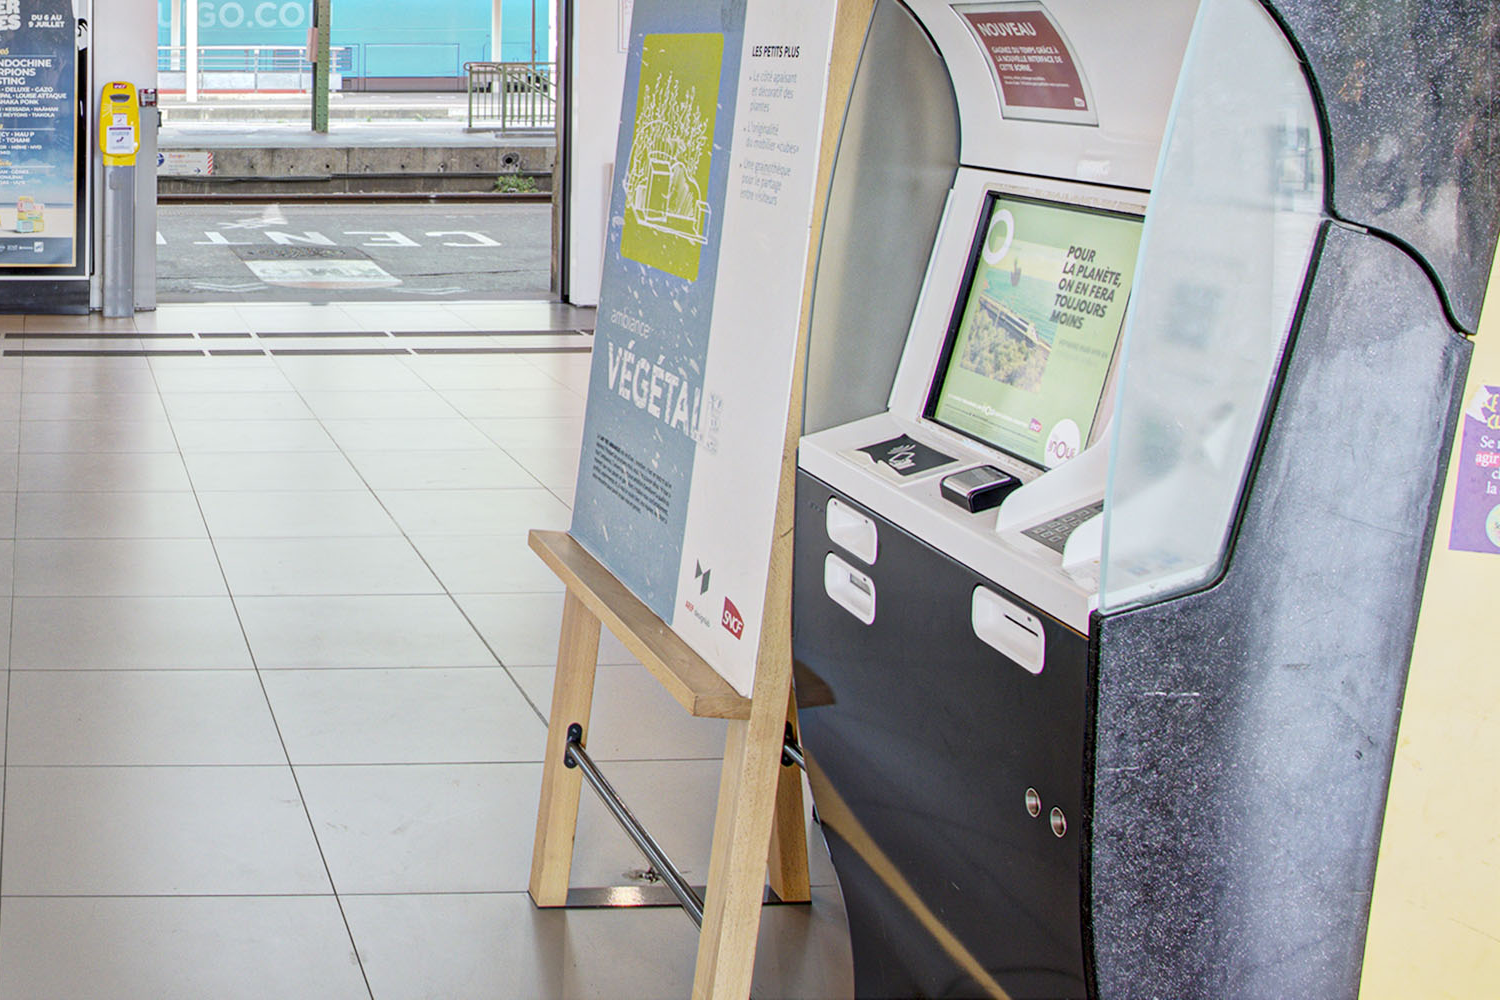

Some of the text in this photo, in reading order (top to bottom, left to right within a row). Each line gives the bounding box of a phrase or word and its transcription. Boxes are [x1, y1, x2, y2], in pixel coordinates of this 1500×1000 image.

[977, 22, 1037, 37] NOUVEAU
[751, 45, 801, 58] LES PETITS PLUS
[1012, 46, 1020, 54] DU
[995, 55, 1003, 63] LA
[1003, 55, 1027, 63] NOUVELLE
[1028, 55, 1054, 64] INTERFACE
[1067, 246, 1096, 263] POUR
[1063, 262, 1122, 288] LA PLANÈTE,
[1058, 277, 1115, 303] ON EN FERA
[1054, 293, 1108, 319] TOUJOURS
[611, 308, 651, 340] ambiance
[1051, 309, 1085, 330] MOINS
[1480, 435, 1495, 448] Se
[1475, 451, 1500, 468] agir
[1486, 480, 1498, 494] la
[722, 610, 743, 634] SNCF
